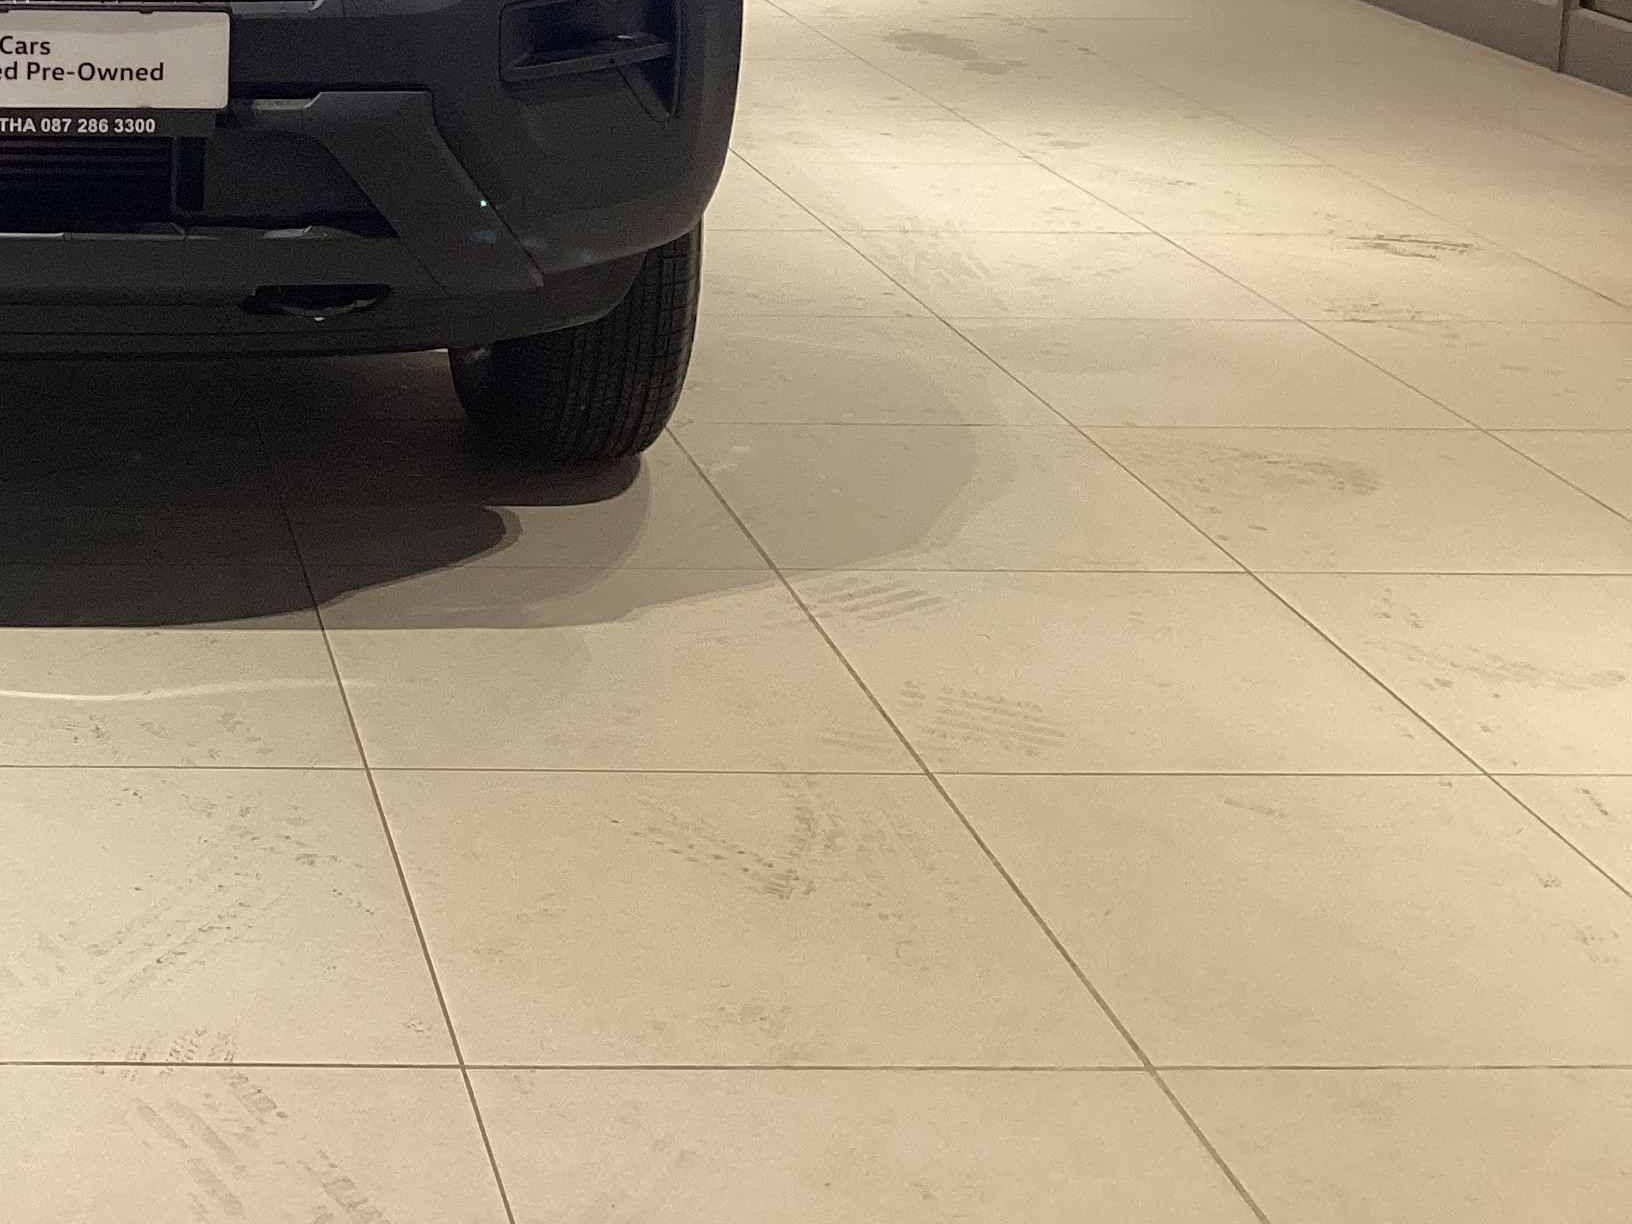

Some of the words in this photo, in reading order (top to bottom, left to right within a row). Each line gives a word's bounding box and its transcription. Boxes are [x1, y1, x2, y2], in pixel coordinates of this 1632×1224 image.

[26, 61, 164, 81] Pre-Owned
[40, 118, 72, 133] 087
[77, 118, 109, 133] 286
[113, 118, 156, 133] 3300
